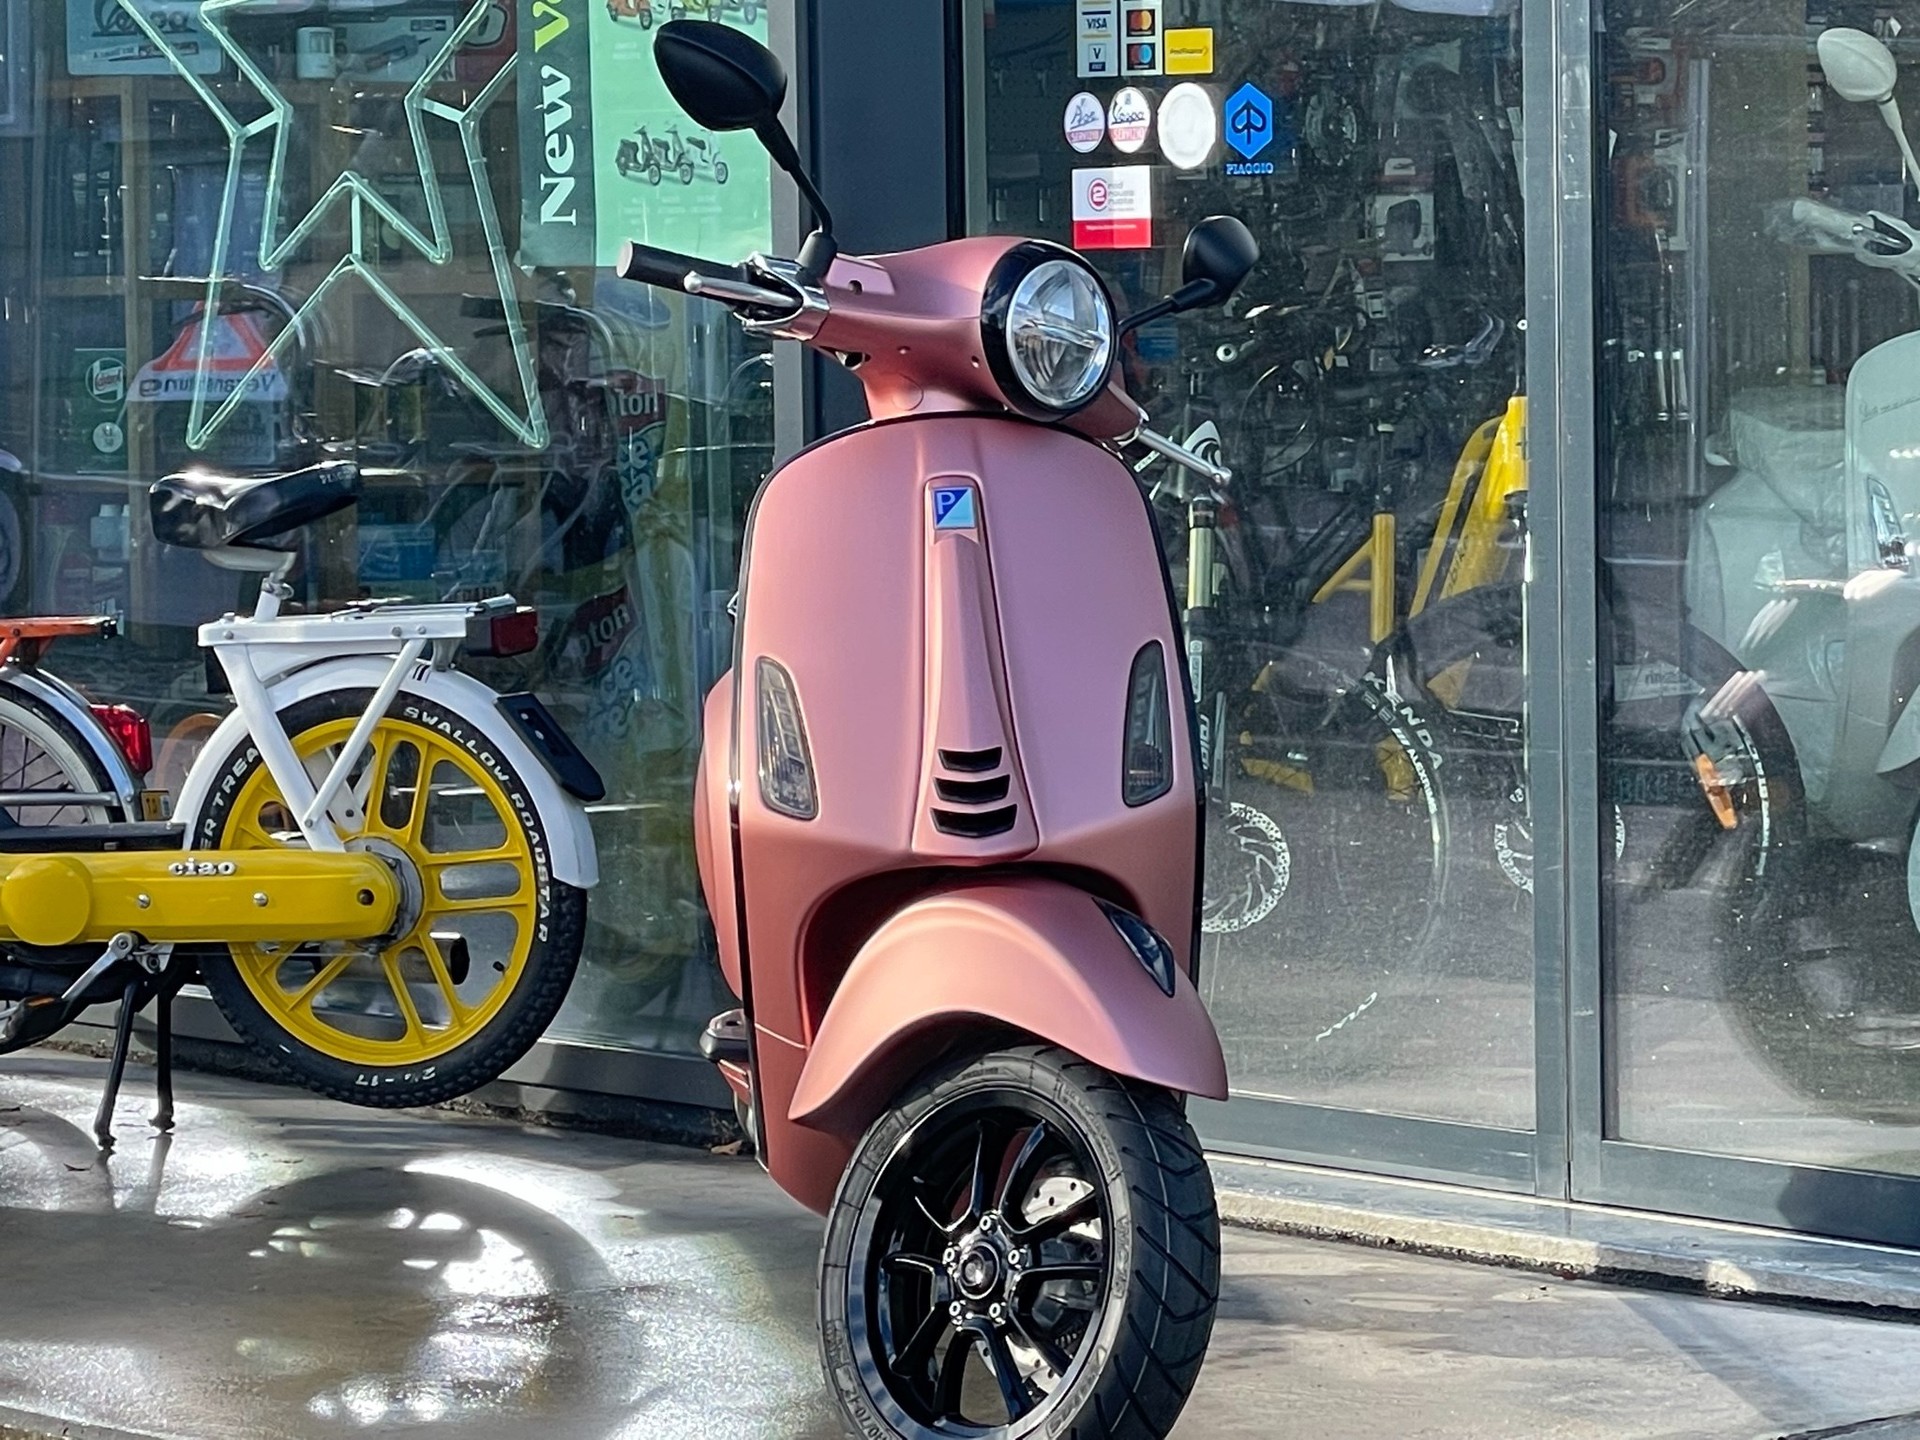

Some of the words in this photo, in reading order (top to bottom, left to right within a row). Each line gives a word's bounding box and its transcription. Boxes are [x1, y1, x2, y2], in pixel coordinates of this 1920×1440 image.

[532, 0, 570, 53] V
[1086, 17, 1108, 30] VISA
[1111, 101, 1145, 125] Vespa
[540, 64, 577, 226] New
[1226, 162, 1274, 175] PIAGGIO
[935, 491, 956, 515] P
[212, 747, 260, 807] TREA
[1406, 748, 1438, 815] ALEXRIMS
[168, 857, 236, 876] ciao
